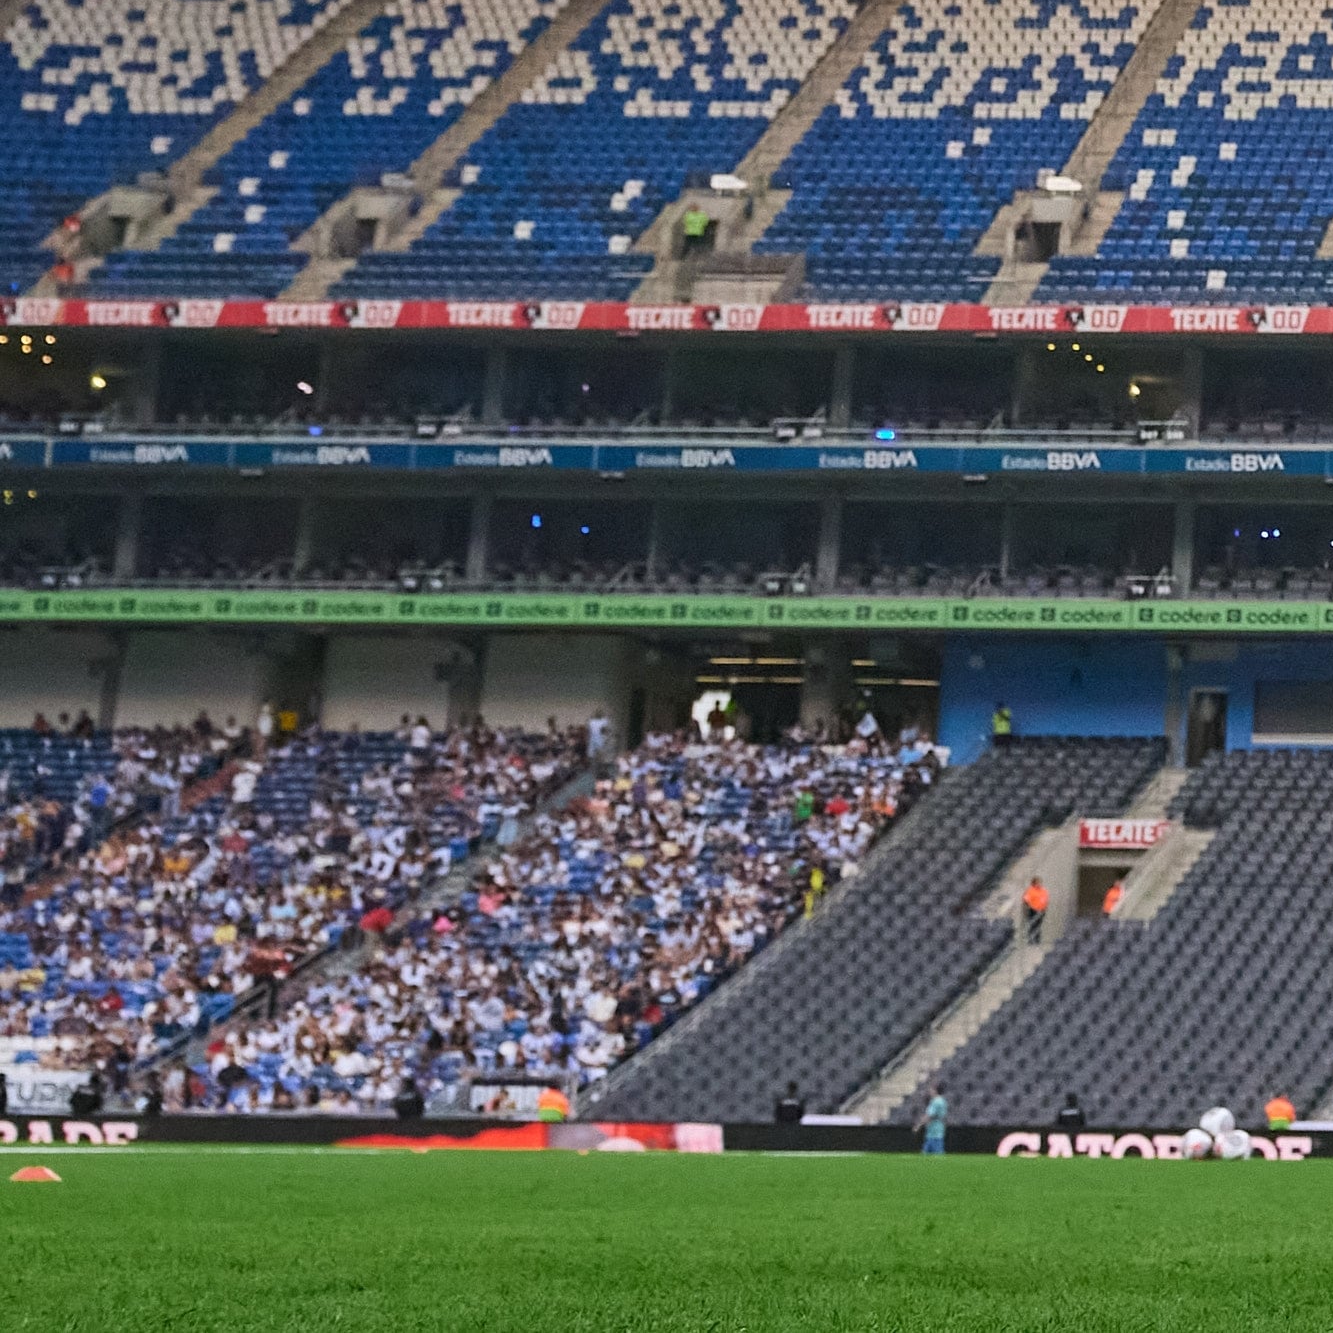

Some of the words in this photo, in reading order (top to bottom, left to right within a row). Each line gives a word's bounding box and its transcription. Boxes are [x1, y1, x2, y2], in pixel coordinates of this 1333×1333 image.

[626, 305, 695, 326] TECATE
[806, 306, 877, 327] TECATE
[988, 307, 1059, 328] TECATE
[1170, 309, 1241, 330] TECATE
[132, 445, 187, 463] BBVA
[317, 447, 372, 465] BBVA
[499, 448, 554, 466] BBVA
[680, 449, 735, 467] BBVA
[862, 450, 917, 468] BBVA
[1046, 451, 1101, 469] BBVA
[1229, 452, 1284, 470] BBVA
[1084, 819, 1156, 841] TECATE
[0, 1120, 139, 1145] RADE
[996, 1132, 1314, 1161] GATORDE
